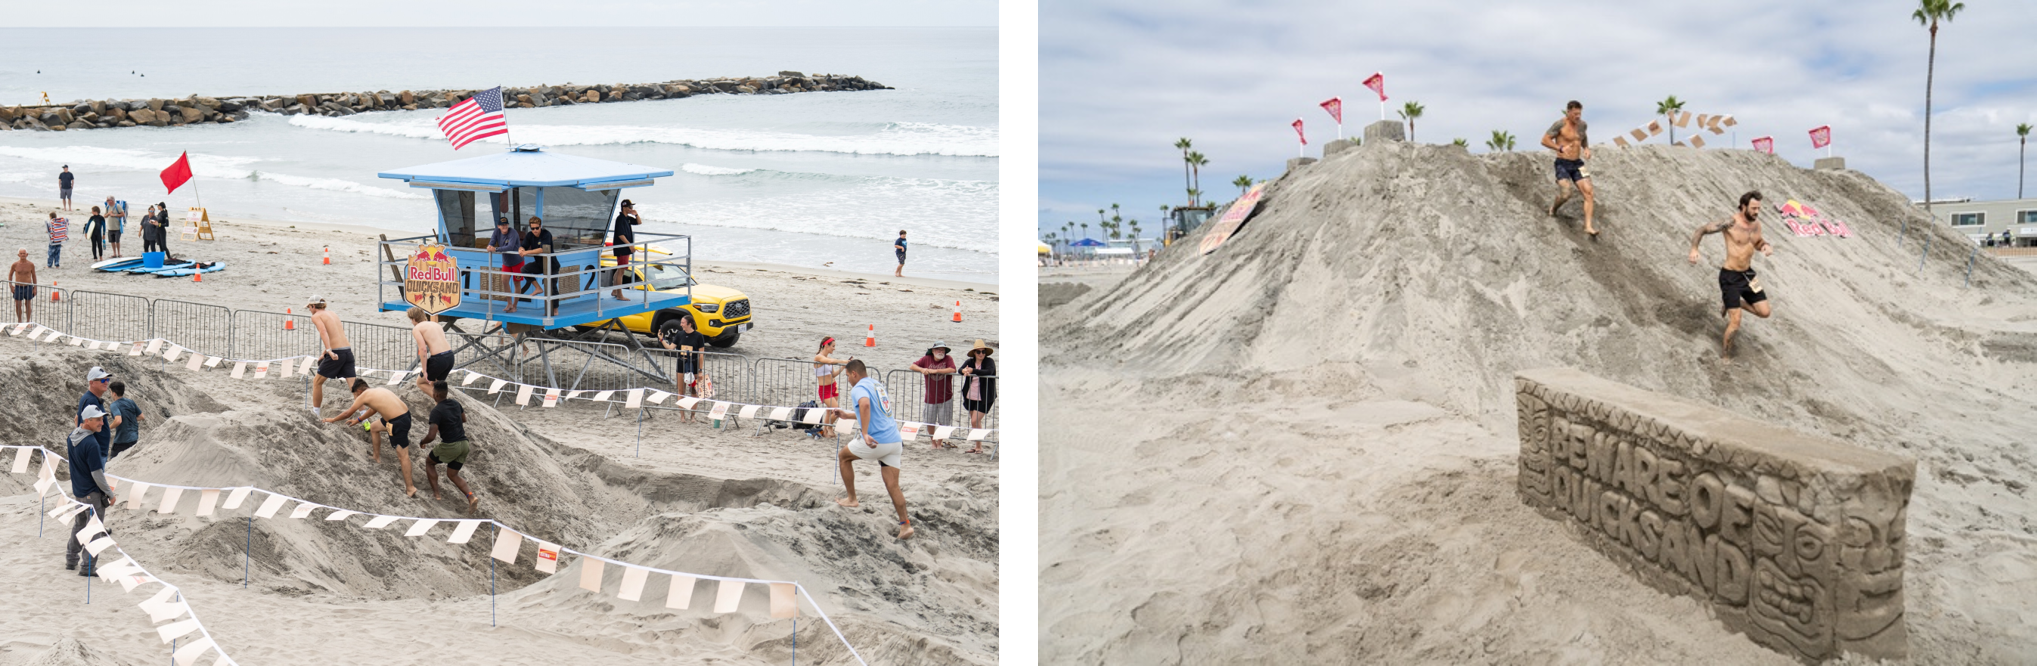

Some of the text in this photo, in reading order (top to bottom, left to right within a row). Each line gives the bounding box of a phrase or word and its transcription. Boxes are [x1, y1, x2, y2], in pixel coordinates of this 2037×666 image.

[1785, 218, 1825, 237] Red
[410, 266, 455, 281] Red Bull
[584, 264, 596, 294] 2
[406, 281, 459, 294] QUICKSAND
[1553, 416, 1756, 543] BEWARE OF
[1553, 465, 1750, 602] QUICKSAND
